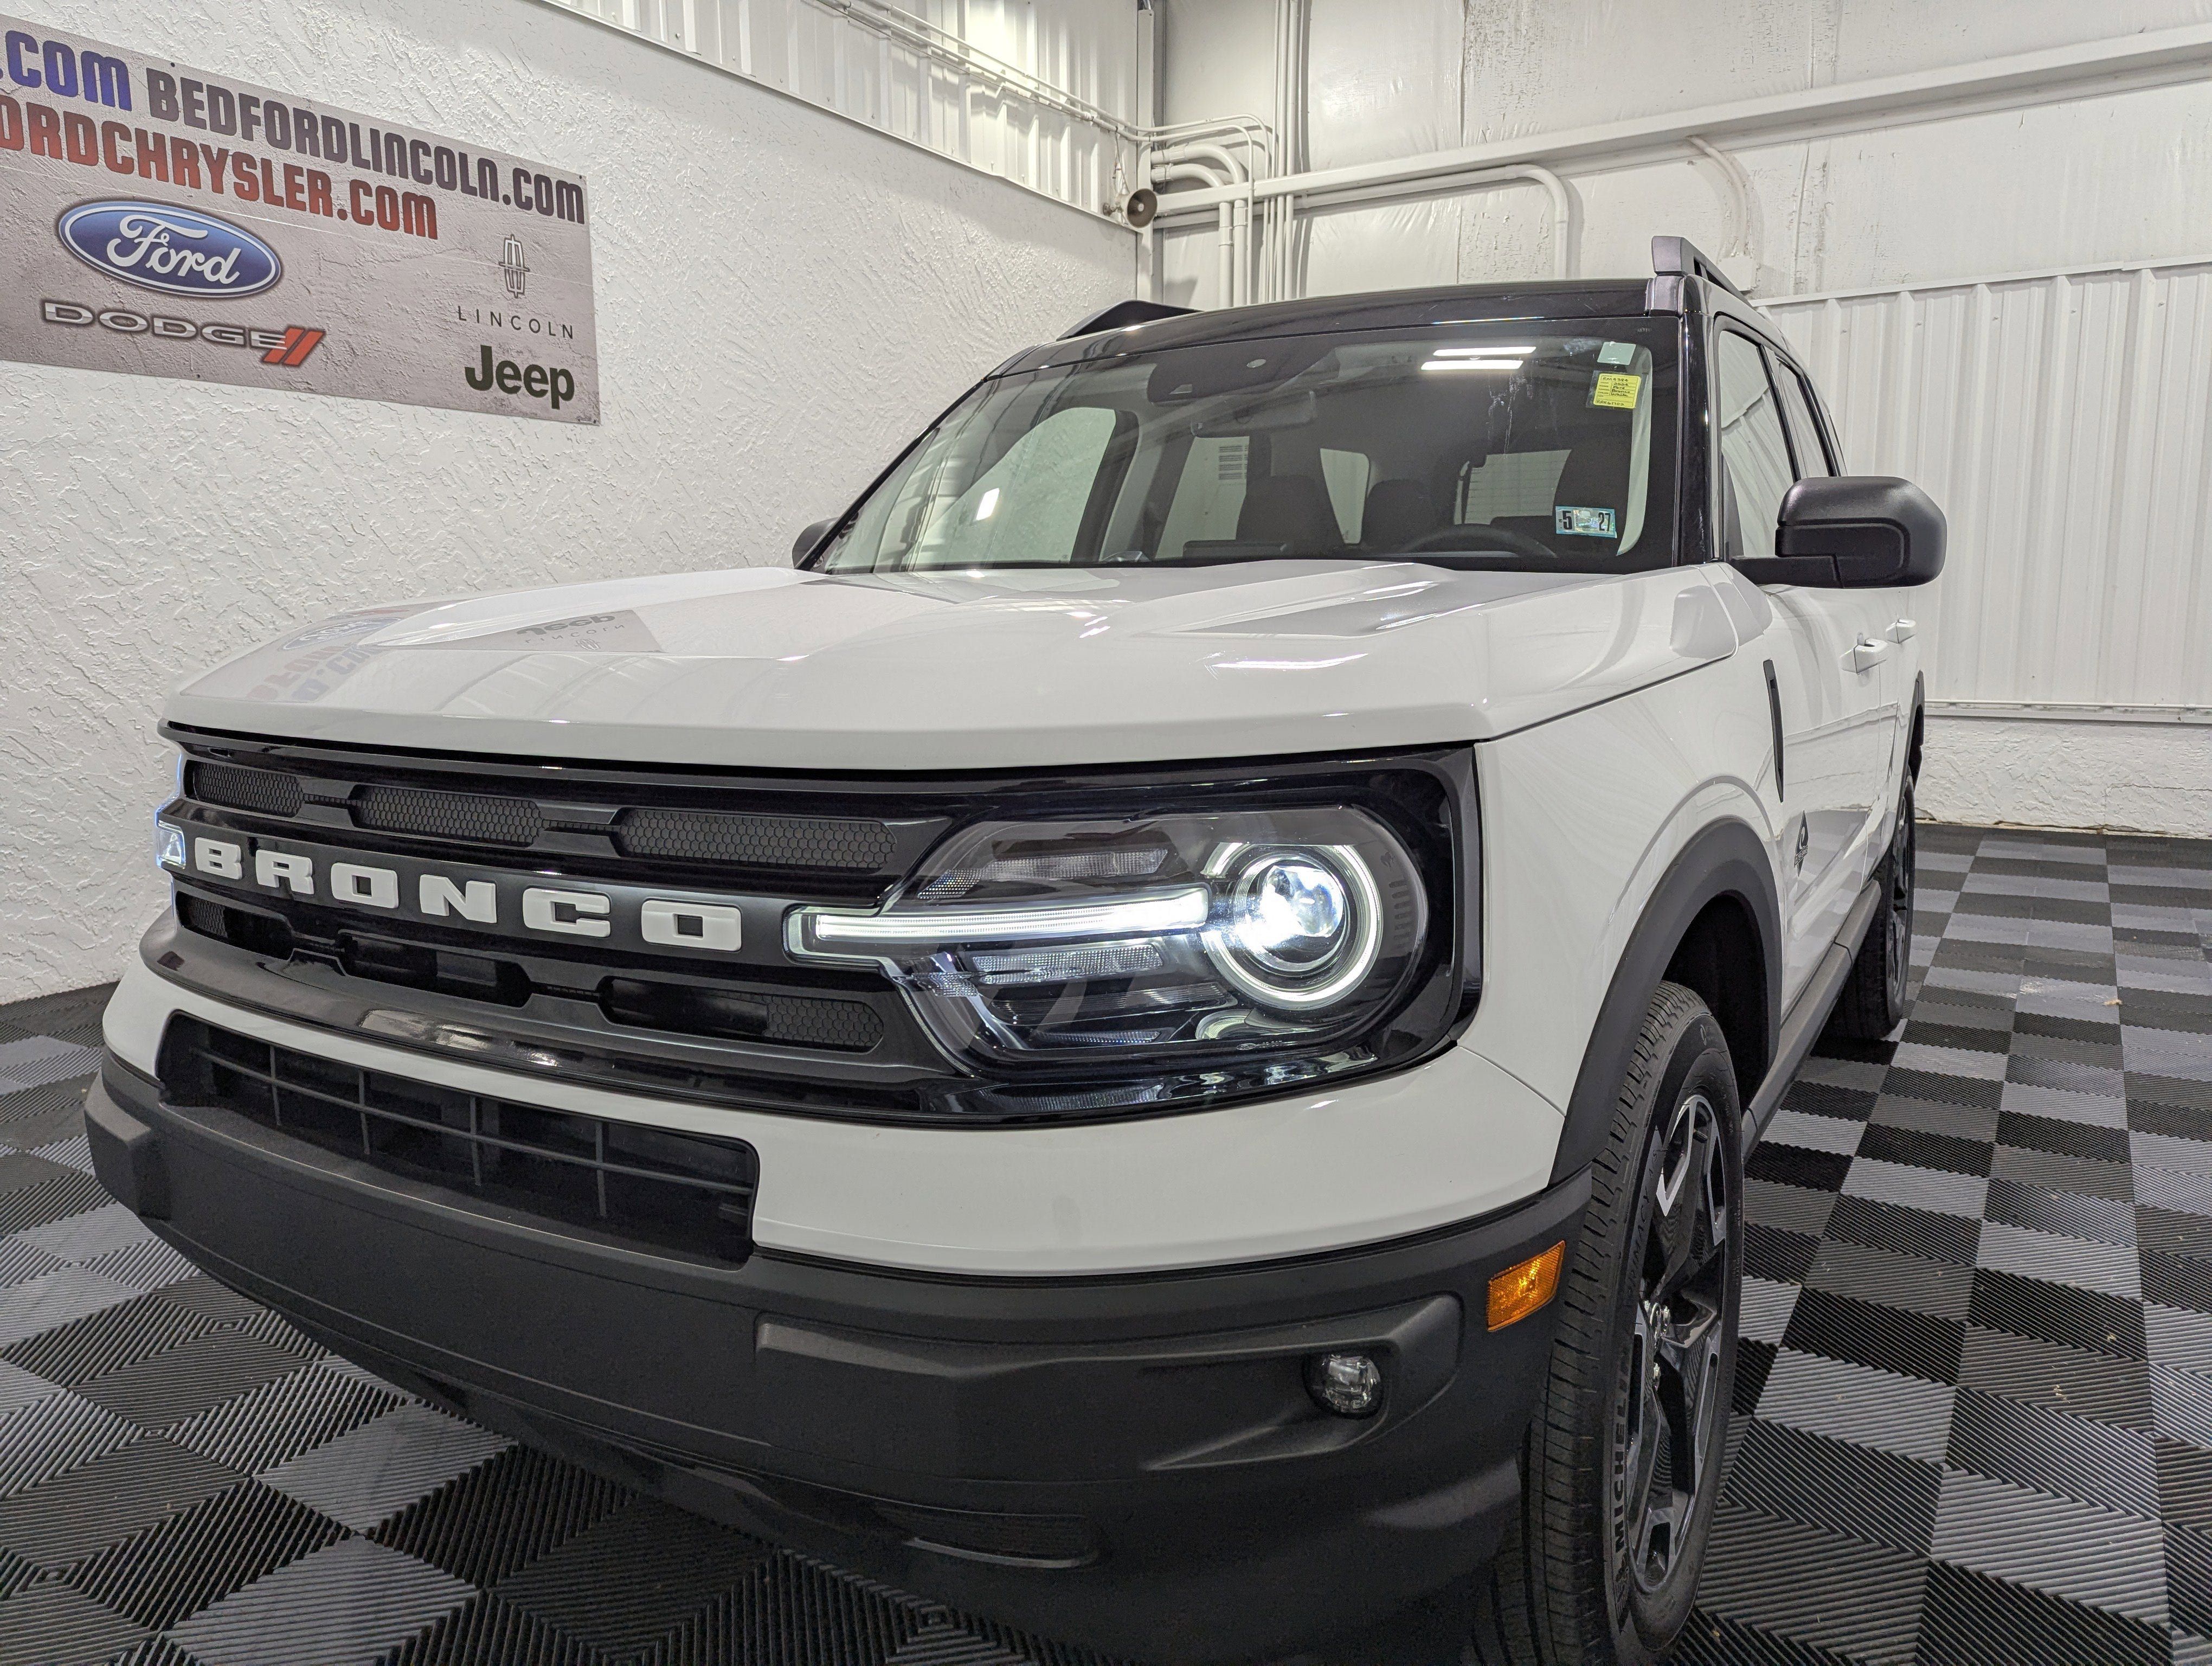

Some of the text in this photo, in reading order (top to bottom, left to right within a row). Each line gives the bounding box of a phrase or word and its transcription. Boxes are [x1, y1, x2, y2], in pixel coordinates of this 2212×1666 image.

[146, 67, 584, 224] BEDFORDLINCOLN.COM
[107, 213, 241, 286] Ford
[44, 302, 290, 351] DODGE
[458, 305, 574, 339] LINCOLN
[465, 345, 575, 409] Jeep
[1562, 510, 1572, 530] 5
[1598, 512, 1611, 531] 27
[194, 836, 743, 952] BRONCO
